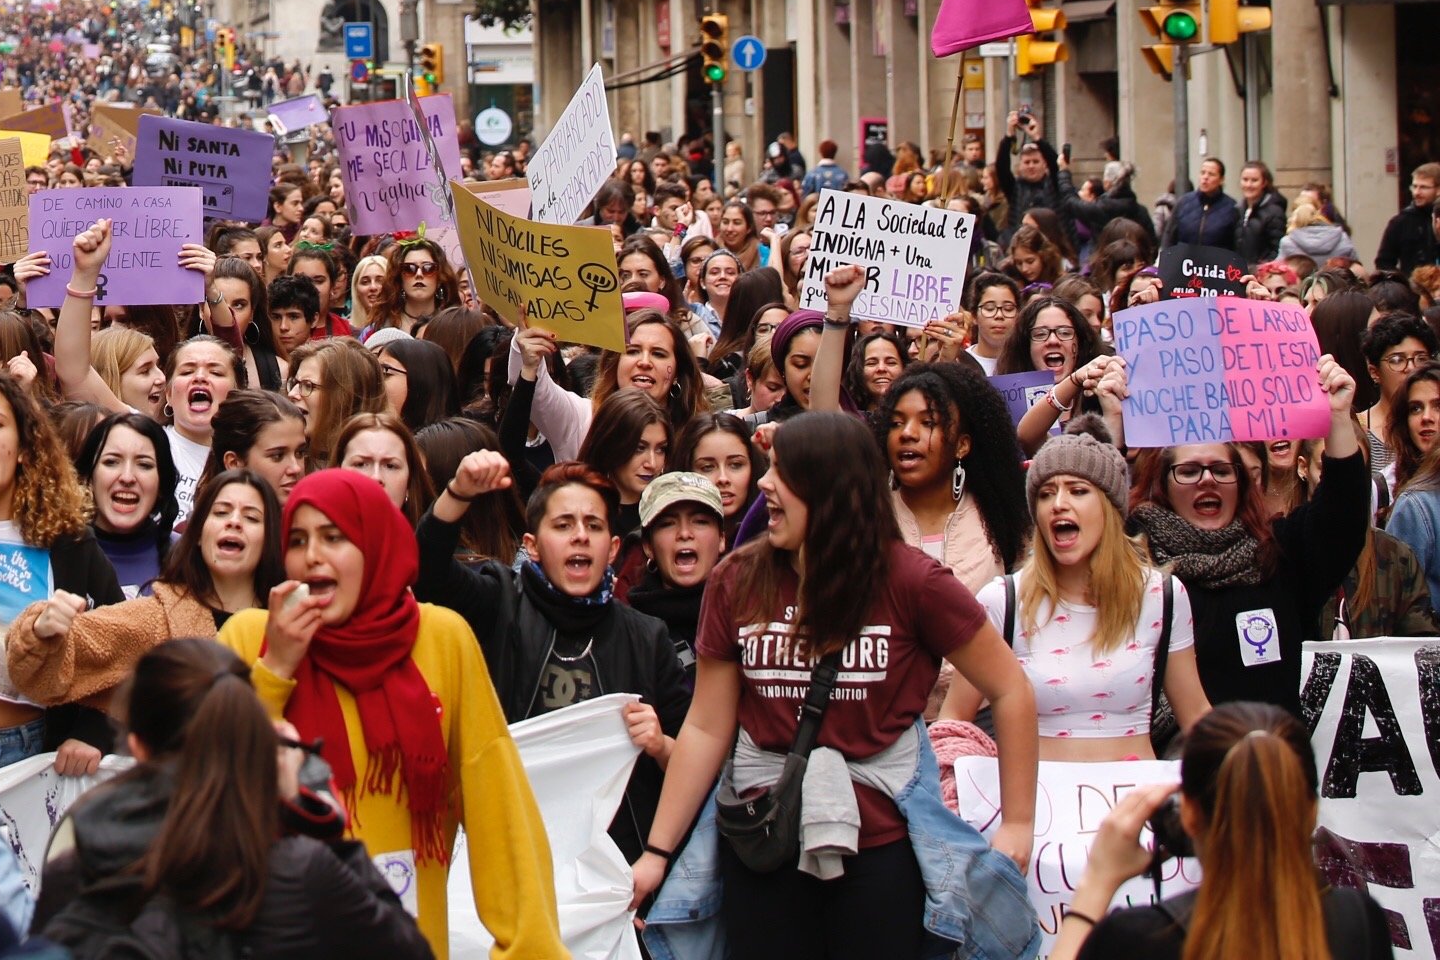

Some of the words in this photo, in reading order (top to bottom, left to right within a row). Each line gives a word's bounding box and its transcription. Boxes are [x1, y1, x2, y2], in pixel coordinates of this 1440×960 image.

[187, 137, 240, 157] SANTA
[339, 121, 355, 148] TU
[531, 171, 544, 191] EL
[541, 82, 603, 185] PATRIARCADO
[189, 161, 227, 179] PUTA
[347, 155, 364, 183] ME
[373, 150, 407, 177] SECA
[43, 198, 64, 212] DE
[131, 197, 139, 207] A
[143, 196, 172, 208] CASA
[819, 196, 834, 225] A
[842, 199, 866, 230] LA
[877, 204, 947, 238] Sociedad
[954, 217, 967, 239] le
[475, 204, 494, 237] NI
[497, 219, 569, 258] DÓCILES
[50, 254, 71, 270] NO
[480, 239, 496, 268] NI
[497, 252, 571, 291] SUMISAS
[906, 245, 933, 269] Una
[1182, 259, 1242, 281] Cuidate
[485, 268, 499, 295] NI
[891, 269, 953, 304] LIBRE
[1200, 287, 1218, 298] no
[1207, 307, 1241, 336] DE
[1249, 308, 1307, 333] LARGO
[1126, 354, 1139, 385] Y
[1159, 345, 1214, 378] PASO
[1221, 343, 1249, 371] DE
[1279, 342, 1319, 368] ESTA
[1129, 384, 1201, 417] NOCHE
[1204, 378, 1256, 410] BAILO
[1262, 374, 1312, 406] SOLO
[1168, 411, 1234, 443] PARA
